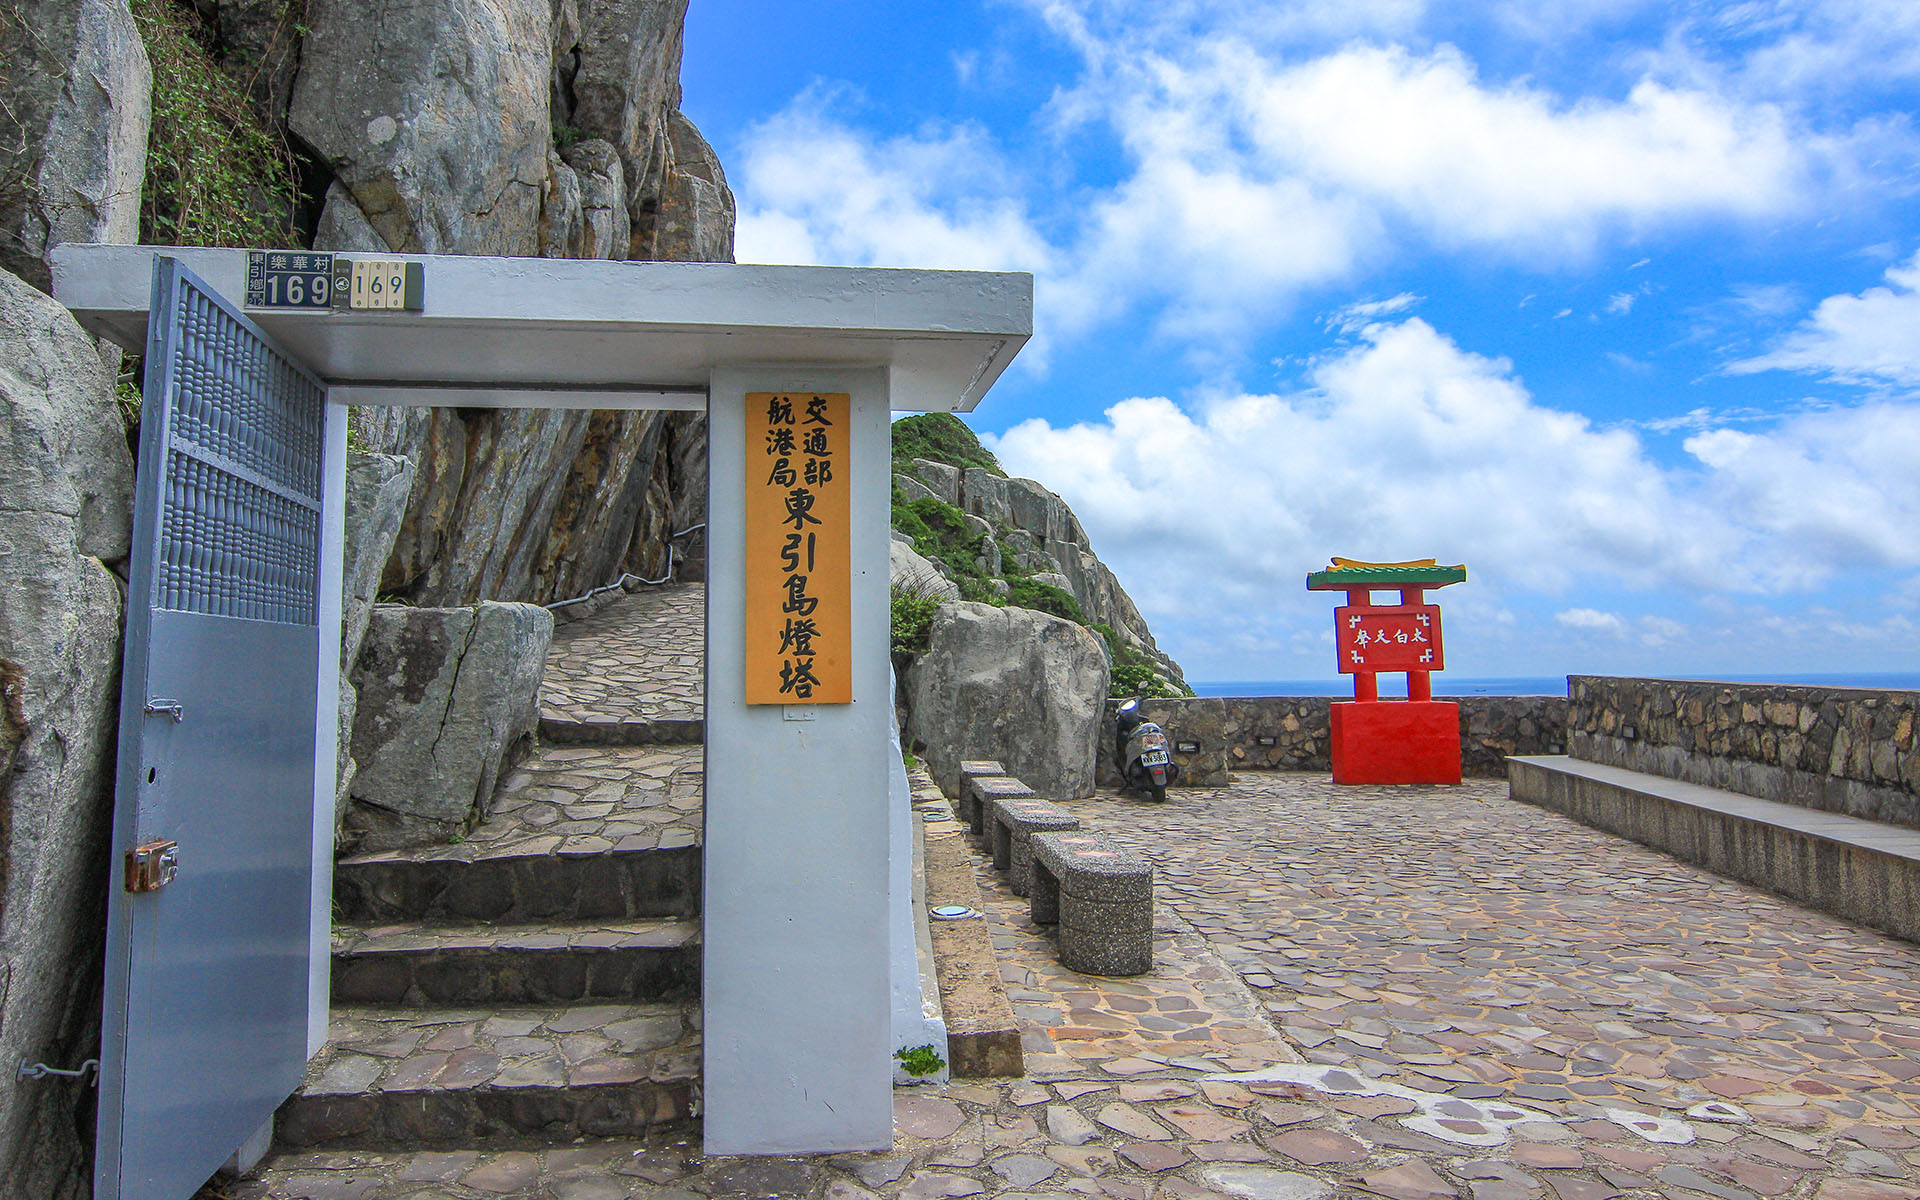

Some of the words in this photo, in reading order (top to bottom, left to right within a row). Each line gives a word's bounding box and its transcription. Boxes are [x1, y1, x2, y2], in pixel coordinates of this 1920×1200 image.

[250, 253, 264, 290] 東引鄉
[270, 256, 330, 271] 樂華村
[267, 275, 329, 305] 169
[356, 275, 402, 294] 169
[765, 396, 797, 488] 航港局
[801, 396, 833, 488] 交通部
[777, 488, 823, 699] 東引島燈塔
